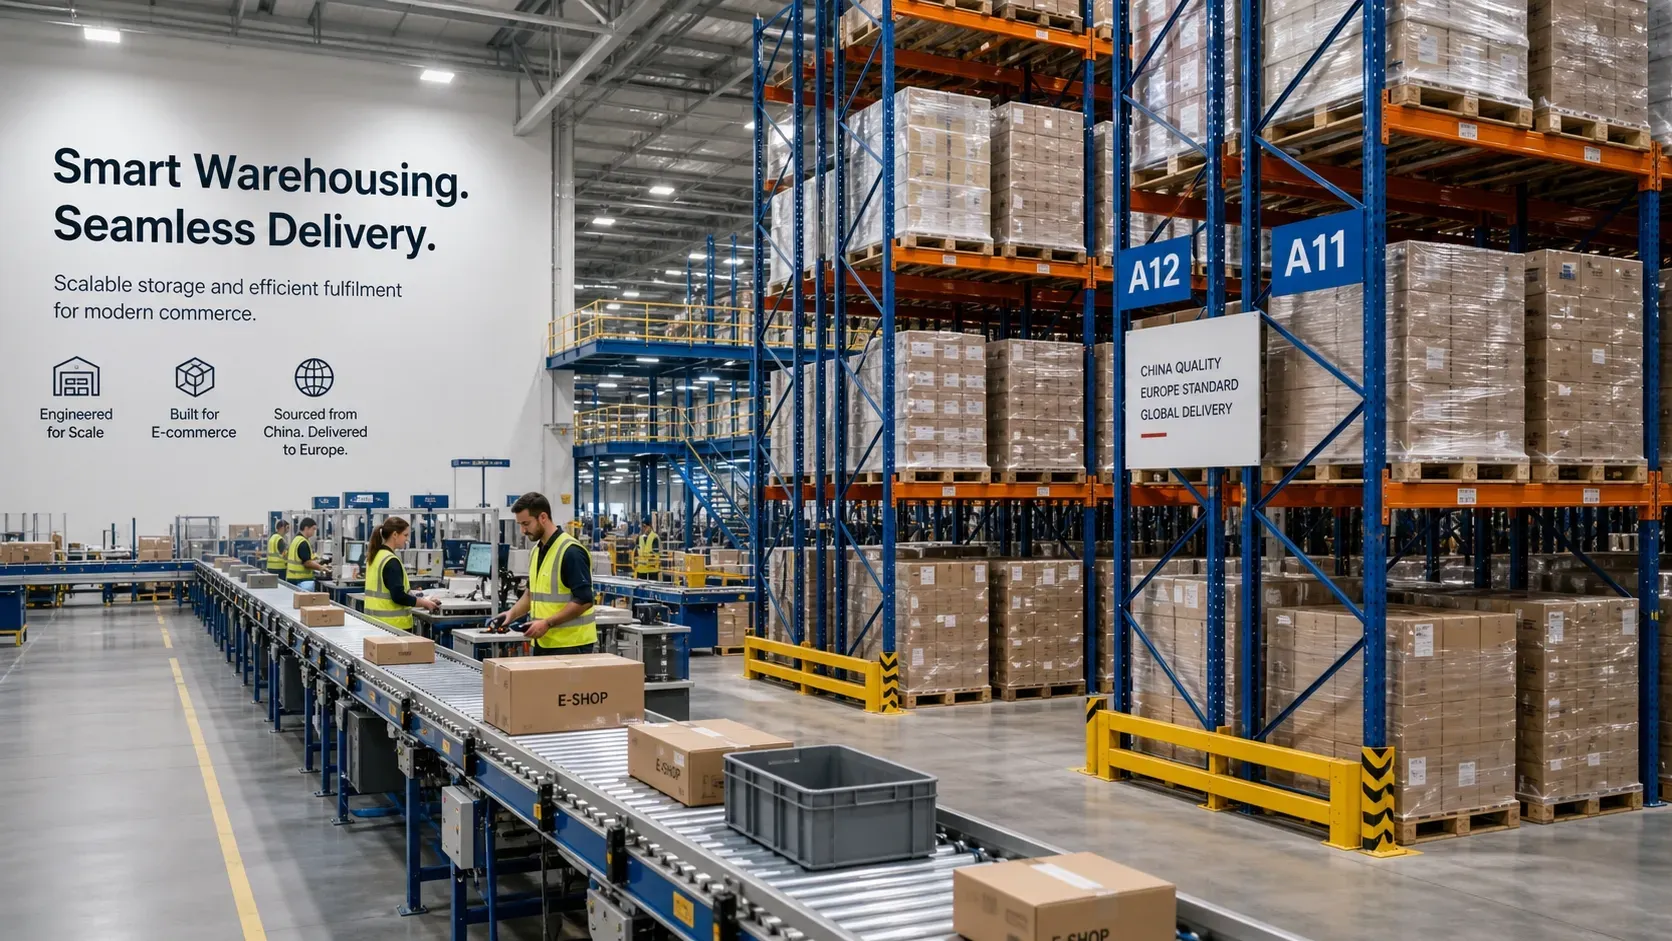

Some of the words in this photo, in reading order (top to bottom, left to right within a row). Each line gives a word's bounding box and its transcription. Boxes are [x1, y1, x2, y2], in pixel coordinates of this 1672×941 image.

[53, 147, 181, 188] Smart
[194, 153, 469, 207] Warehousing.
[53, 205, 255, 246] Seamless
[268, 212, 436, 259] Delivery.
[1284, 229, 1345, 277] A11
[1128, 253, 1180, 294] A12
[54, 275, 132, 293] Scalable
[138, 278, 205, 297] storage
[211, 279, 243, 295] and
[249, 279, 318, 297] efficient
[324, 279, 402, 298] fulfilment
[54, 302, 79, 319] for
[84, 302, 154, 320] modern
[159, 307, 256, 322] commerce.
[1140, 362, 1173, 378] CHINA
[1175, 357, 1222, 375] QUALITY
[1140, 384, 1180, 399] EUROPE
[1182, 378, 1239, 396] STANDARD
[40, 407, 113, 424] Engineered
[170, 407, 198, 421] Built
[201, 407, 219, 421] for
[274, 407, 325, 421] Sourced
[328, 407, 358, 421] from
[1140, 405, 1180, 421] GLOBAL
[1182, 402, 1233, 418] DELIVERY
[47, 425, 66, 439] for
[69, 425, 104, 439] Scale
[152, 425, 237, 439] E-commerce
[263, 425, 304, 438] China.
[308, 425, 368, 438] Delivered
[283, 444, 296, 456] to
[299, 443, 348, 459] Europe.
[558, 691, 608, 707] E-SHOP
[656, 758, 681, 781] E-SHOP
[1052, 928, 1110, 941] SHOP
